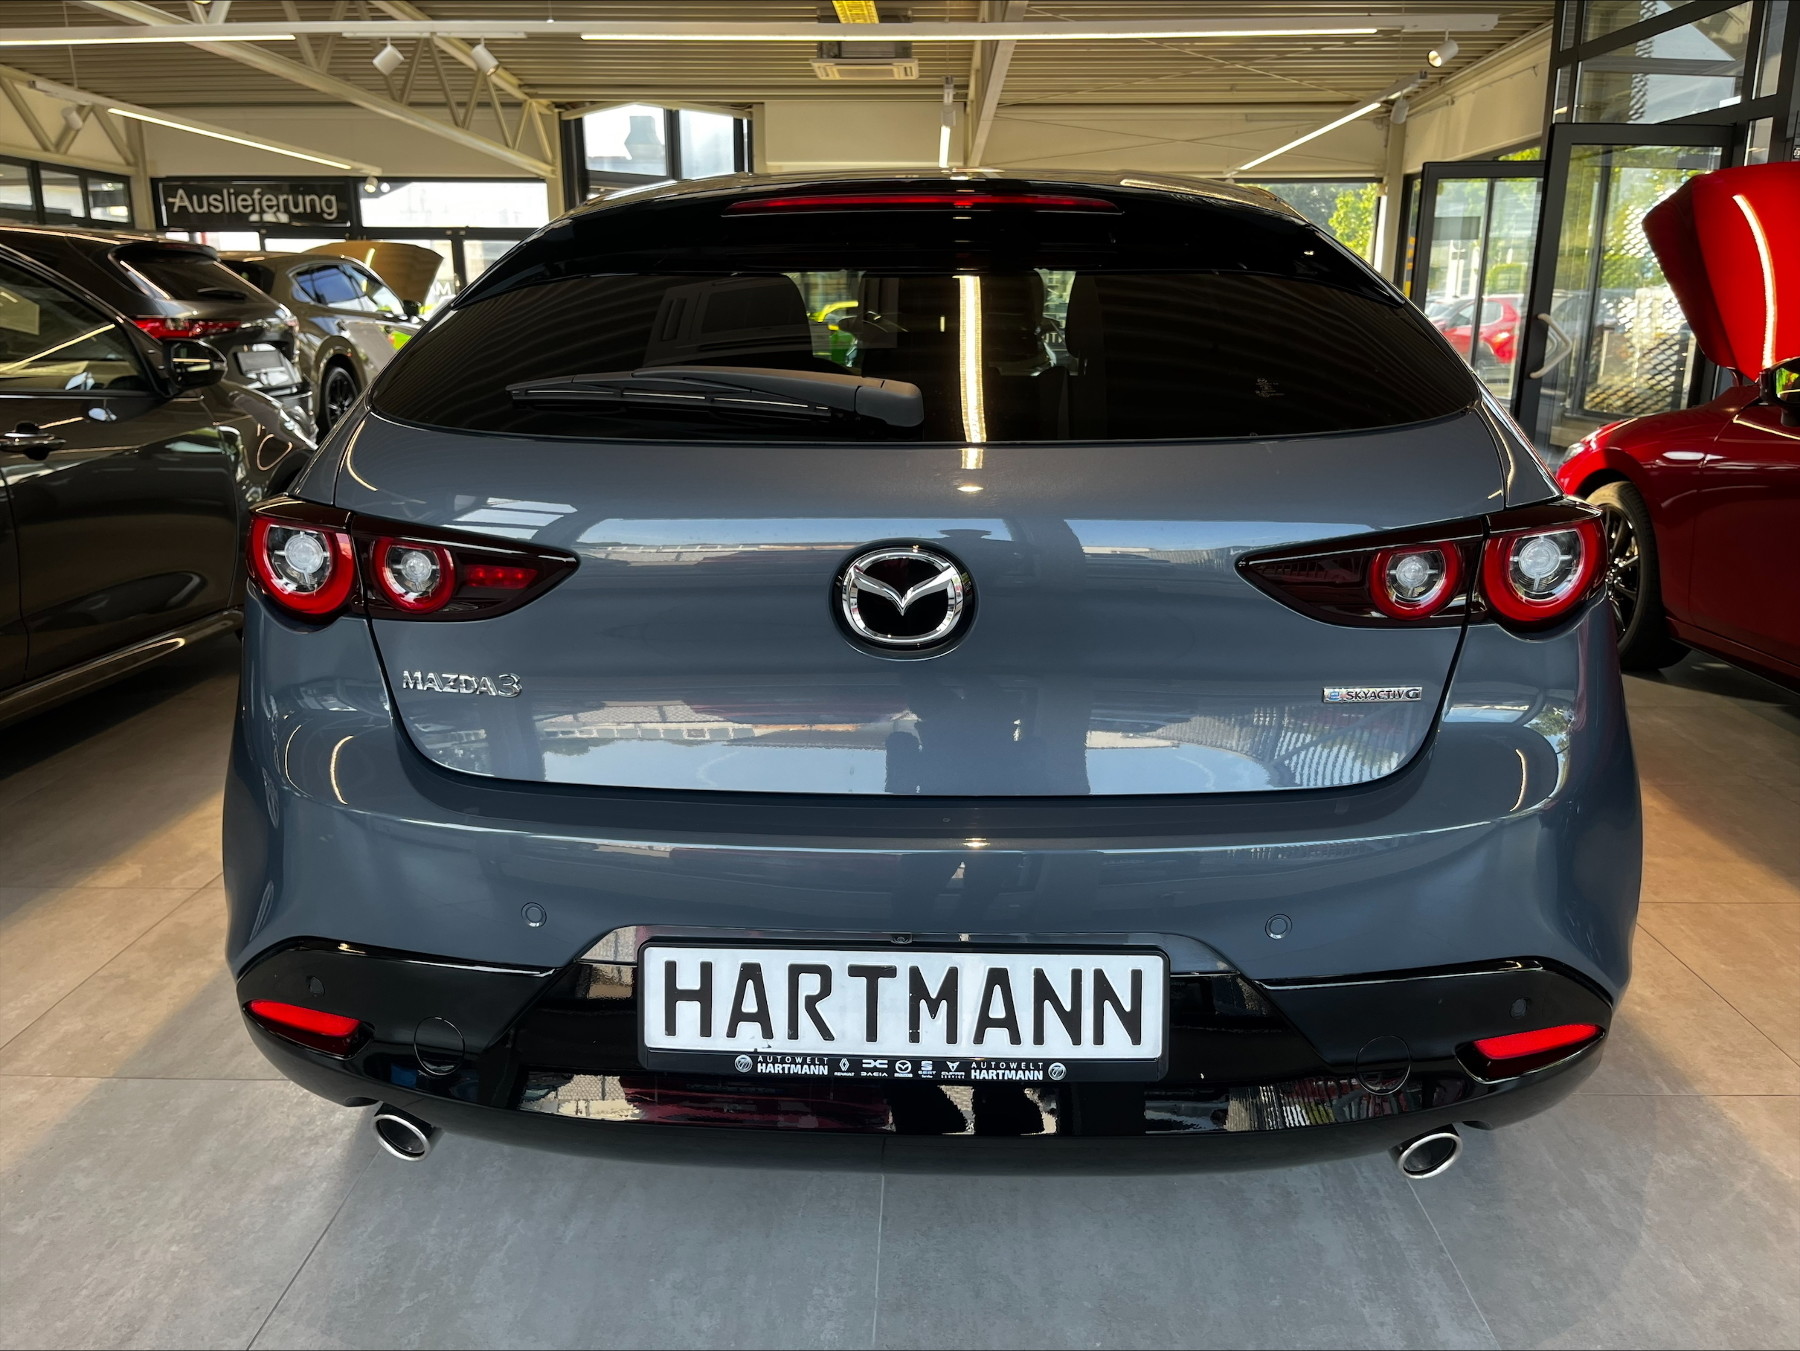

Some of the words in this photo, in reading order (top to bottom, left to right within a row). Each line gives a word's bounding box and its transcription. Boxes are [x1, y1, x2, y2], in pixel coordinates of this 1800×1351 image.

[172, 188, 338, 220] Auslieferung
[663, 959, 1143, 1047] HARTMANN
[757, 1055, 829, 1065] AUTOWELT
[970, 1061, 1044, 1070] AUTOWELT
[757, 1063, 829, 1076] HARTMANN
[970, 1069, 1044, 1081] HARTMANN
